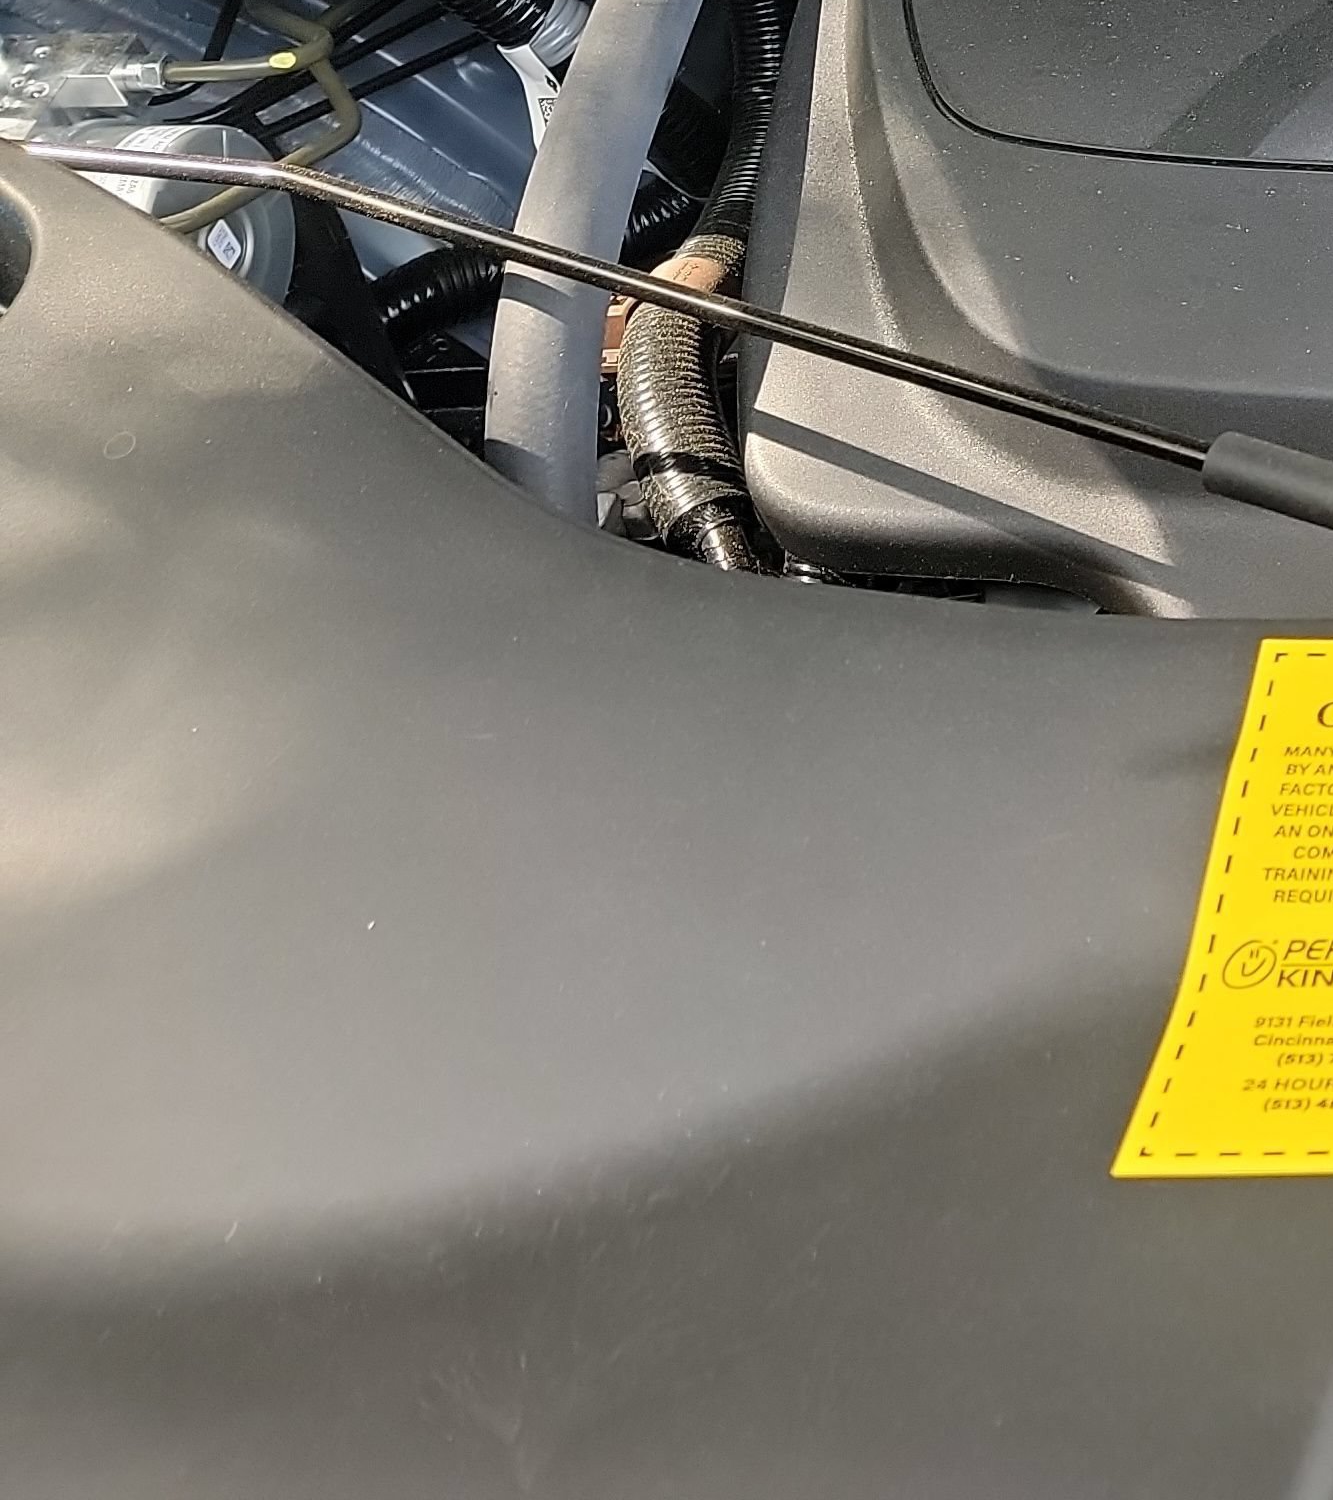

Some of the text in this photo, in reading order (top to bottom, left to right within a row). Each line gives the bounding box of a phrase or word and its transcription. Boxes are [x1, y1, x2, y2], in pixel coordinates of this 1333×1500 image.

[1286, 764, 1312, 776] BY
[1273, 824, 1303, 838] AN
[1277, 1052, 1323, 1068] (513)
[1242, 1078, 1268, 1092] 24
